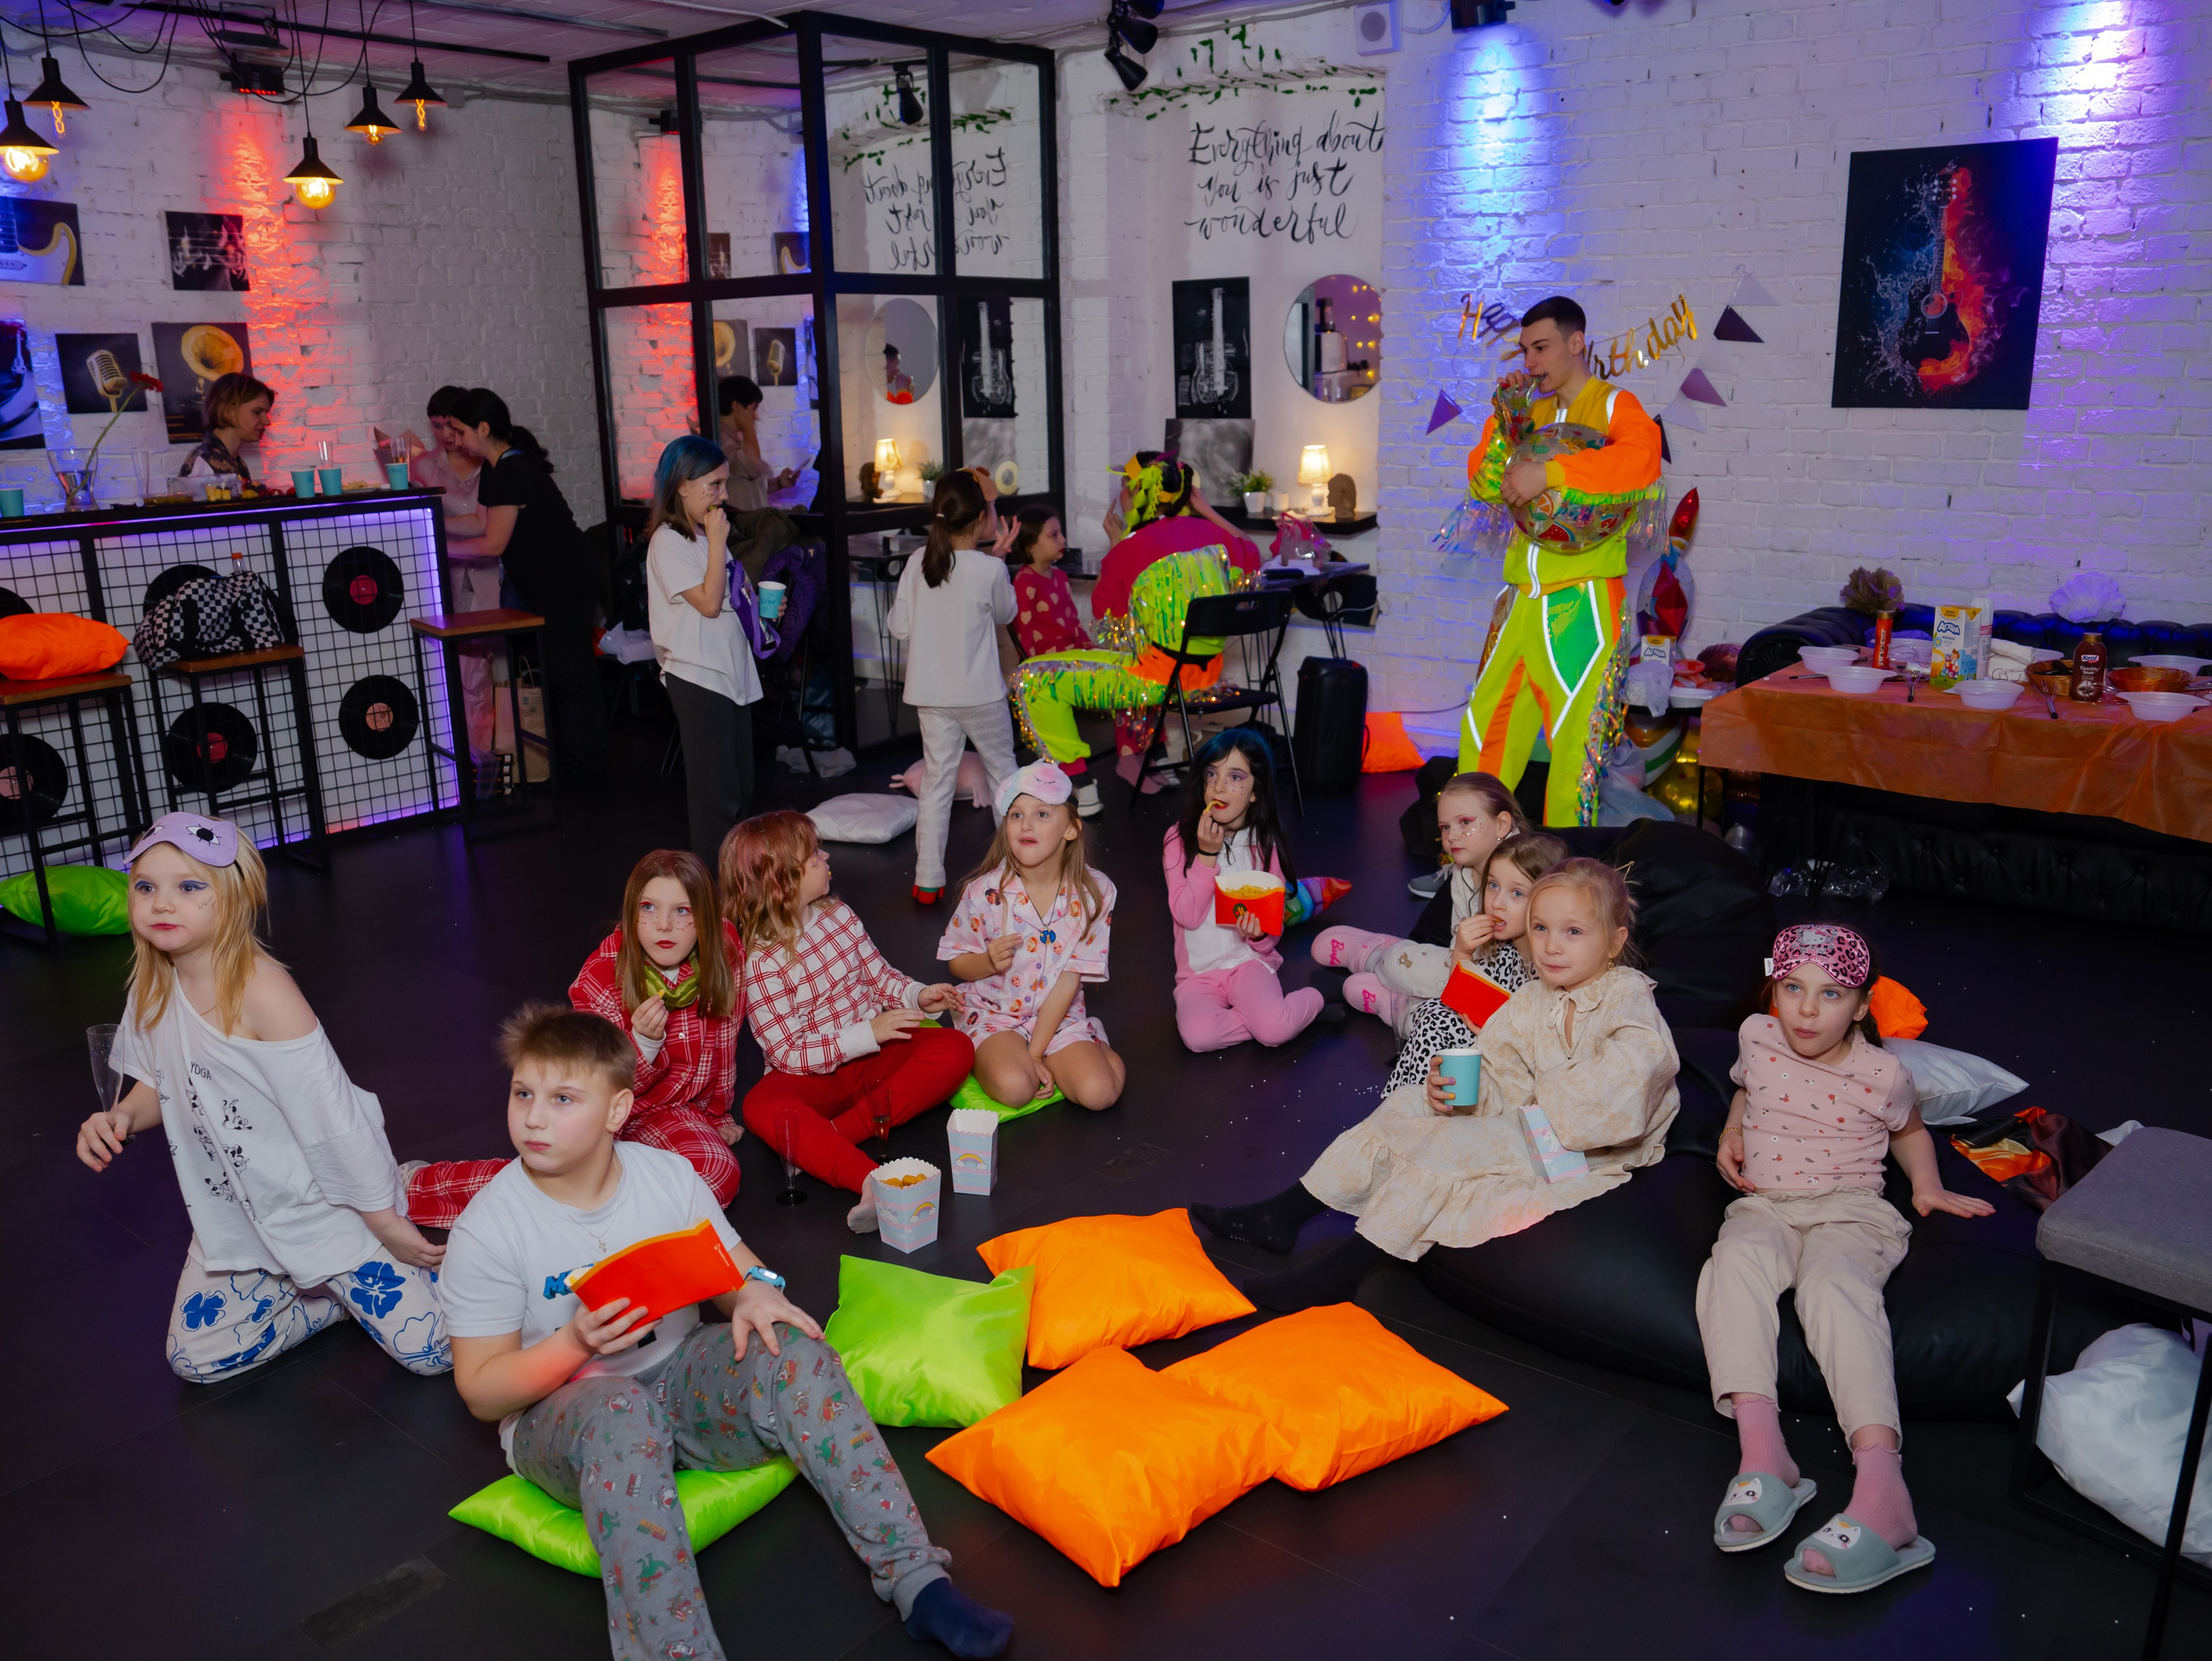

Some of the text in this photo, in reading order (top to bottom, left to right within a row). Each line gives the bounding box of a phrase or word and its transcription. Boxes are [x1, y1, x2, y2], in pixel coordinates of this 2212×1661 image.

[1189, 110, 1385, 175] Everything about
[1198, 158, 1354, 207] you is just
[1185, 202, 1359, 245] wonderful
[190, 1061, 212, 1081] YOGA
